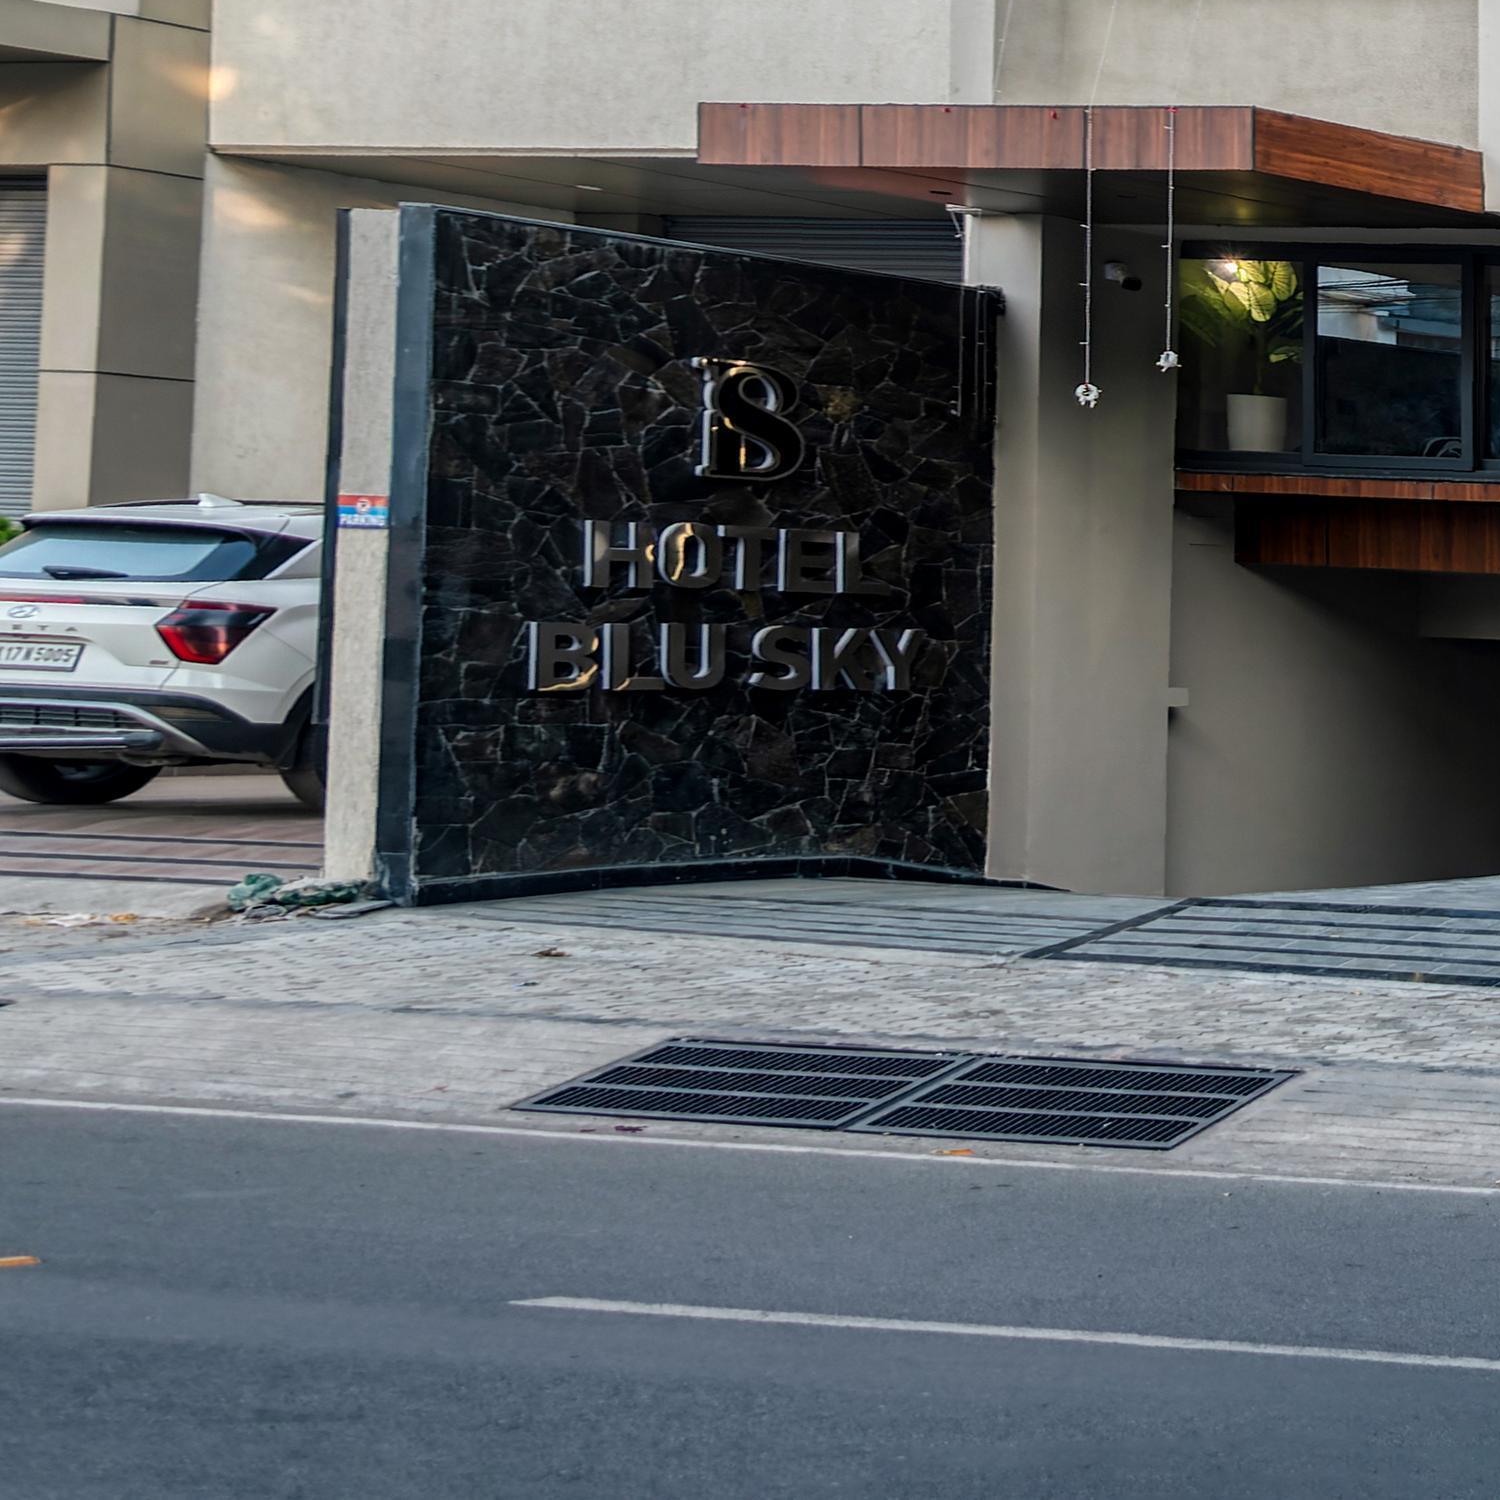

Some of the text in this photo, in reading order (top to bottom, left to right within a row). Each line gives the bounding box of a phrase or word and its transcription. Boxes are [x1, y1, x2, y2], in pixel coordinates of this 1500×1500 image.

[581, 519, 893, 595] HOTEL
[526, 620, 928, 692] BLU SKY
